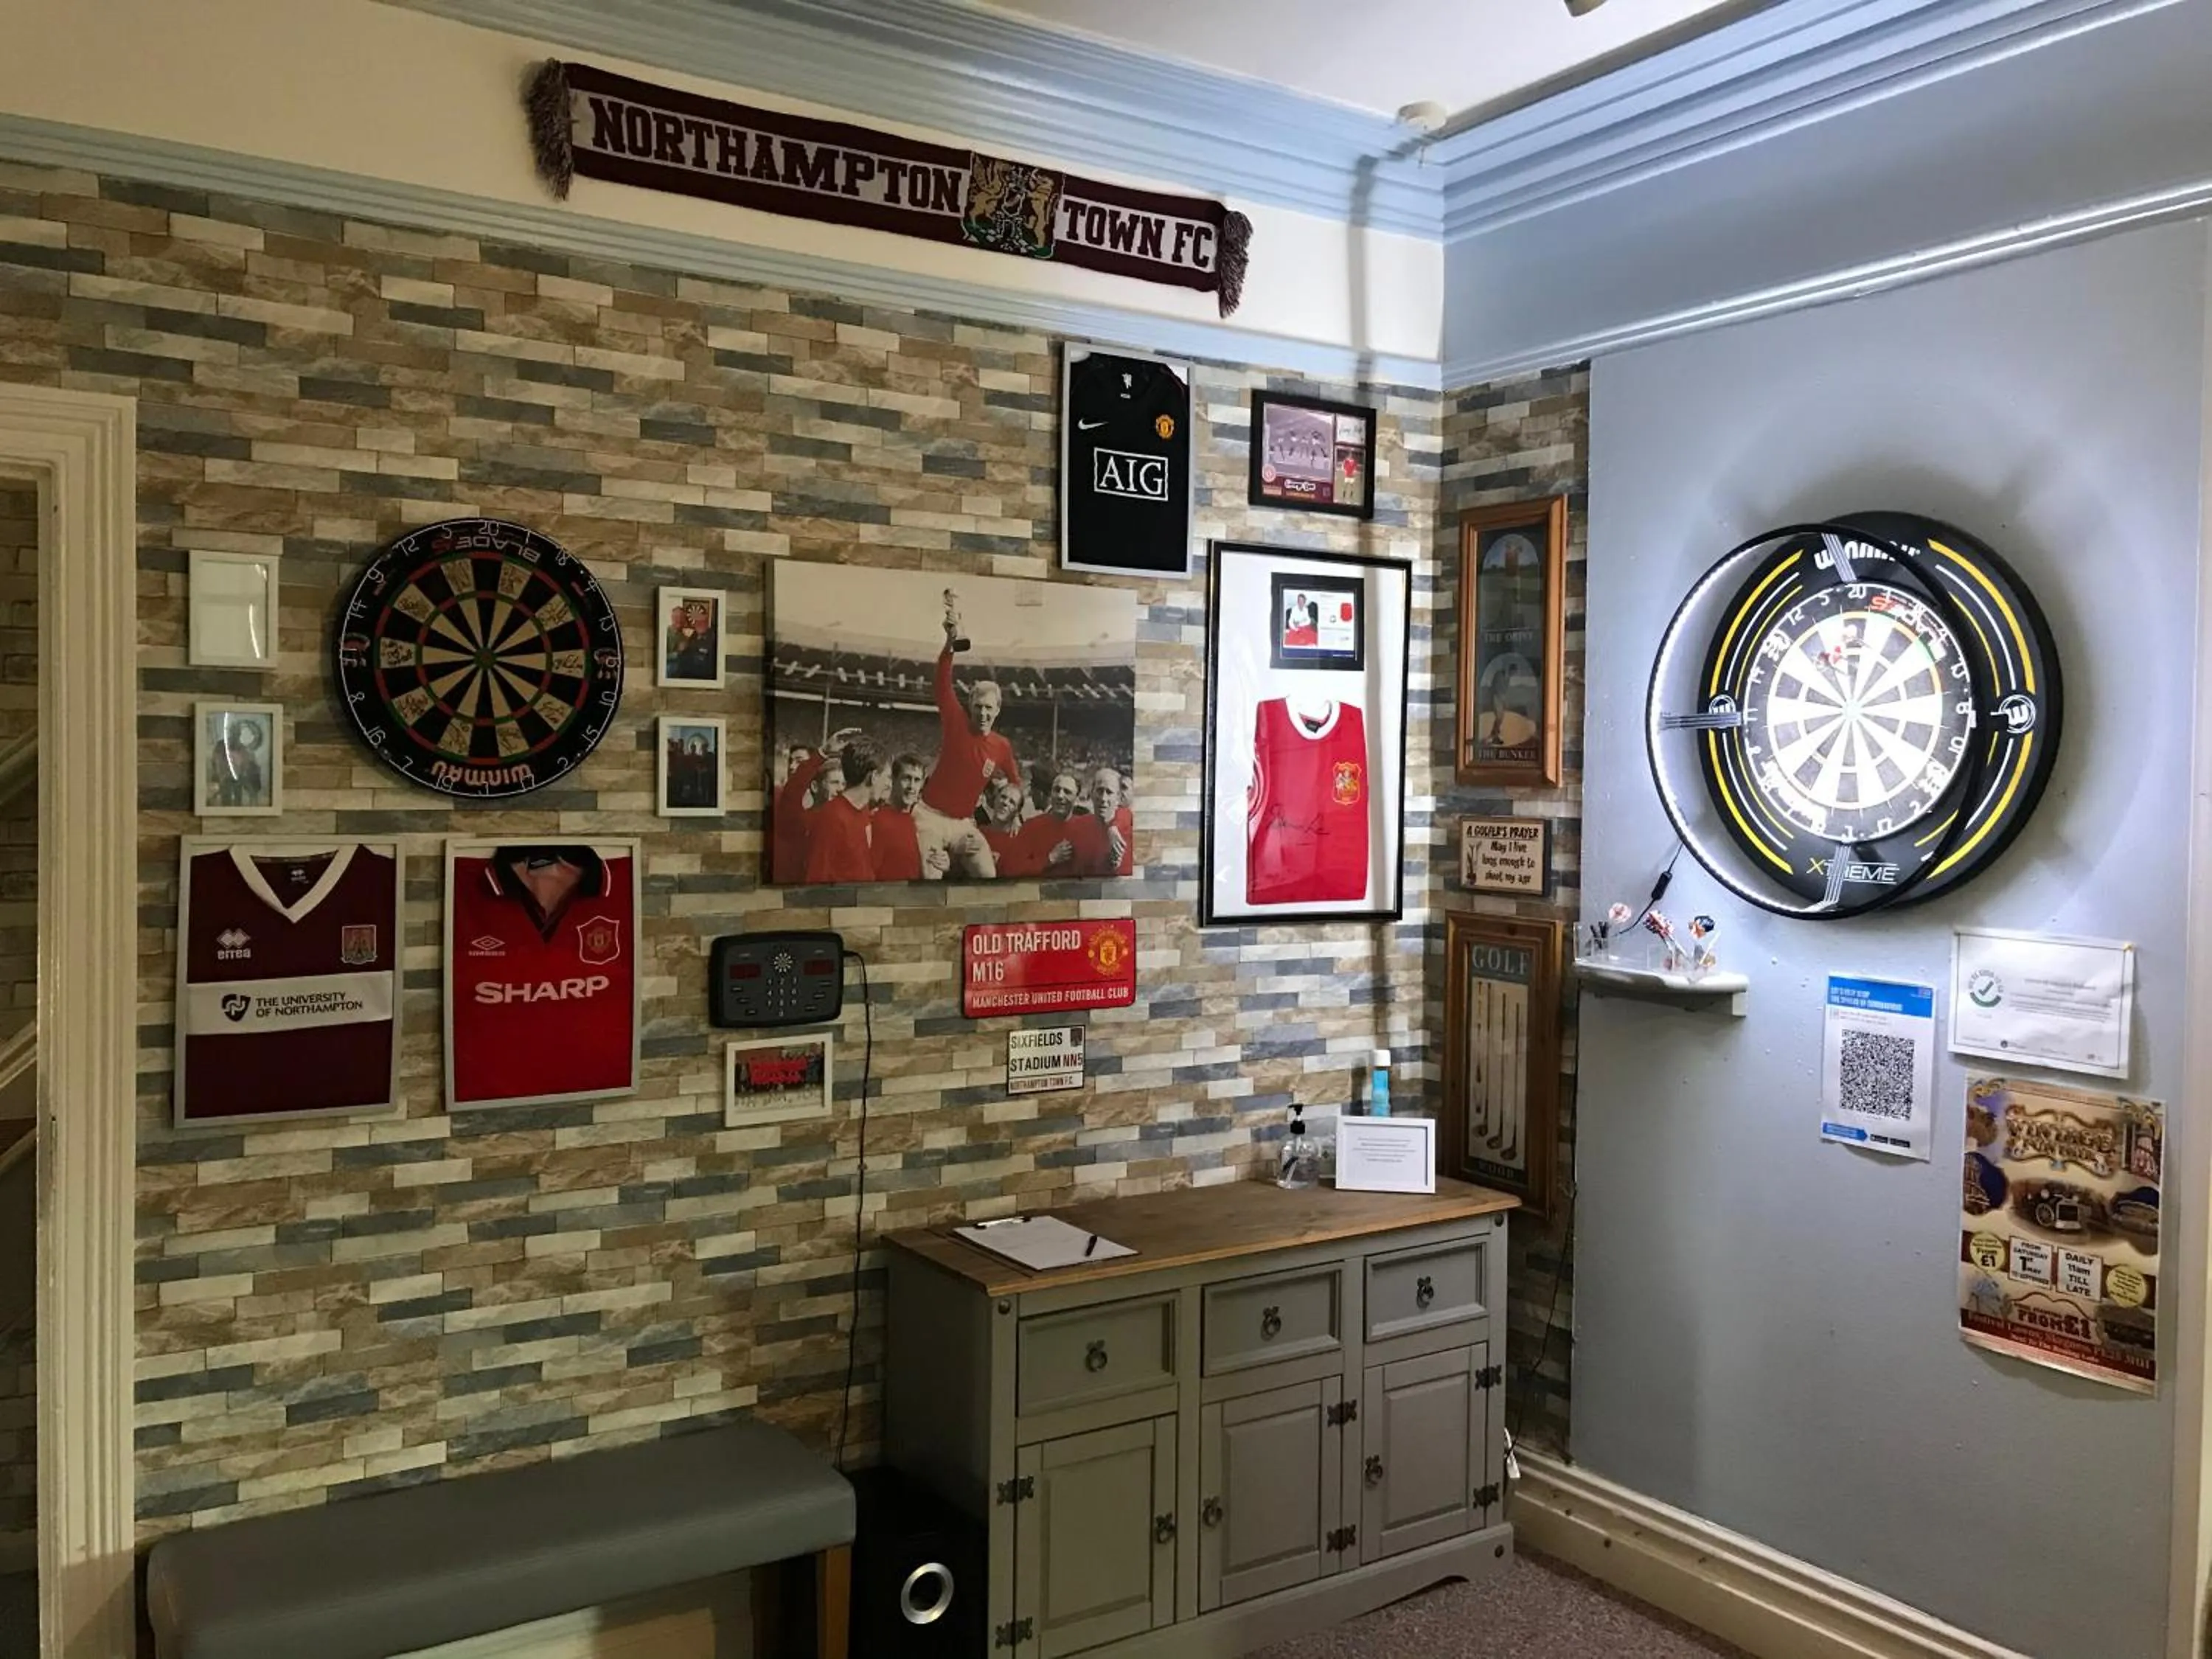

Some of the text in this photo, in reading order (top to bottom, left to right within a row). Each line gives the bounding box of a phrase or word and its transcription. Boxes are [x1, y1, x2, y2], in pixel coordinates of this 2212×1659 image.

[590, 98, 1214, 270] NORTHAMPTON TOWN FC
[1099, 456, 1164, 495] AIG
[479, 521, 499, 536] 20
[455, 535, 541, 563] BLADE
[1847, 584, 1866, 599] 20
[1509, 827, 1539, 838] PRAYER
[1806, 858, 1899, 883] XTEME
[973, 929, 1081, 955] OLD TRAFFORD
[1472, 945, 1530, 975] GOLF
[973, 961, 1004, 983] M16
[474, 975, 610, 1004] SHARP
[973, 987, 1129, 1009] MANCHESTER UNITED FOOTBALL CLUB
[256, 992, 346, 1008] THE UNIVERSITY
[256, 1000, 363, 1018] OF NORTHAMPTON
[1011, 1032, 1062, 1048] SIXFIELDS
[1010, 1052, 1083, 1072] STADIUM NN5
[1981, 1255, 1996, 1267] £1
[2065, 1253, 2094, 1265] DAILY
[2068, 1274, 2088, 1286] TILL
[2066, 1284, 2091, 1296] LATE
